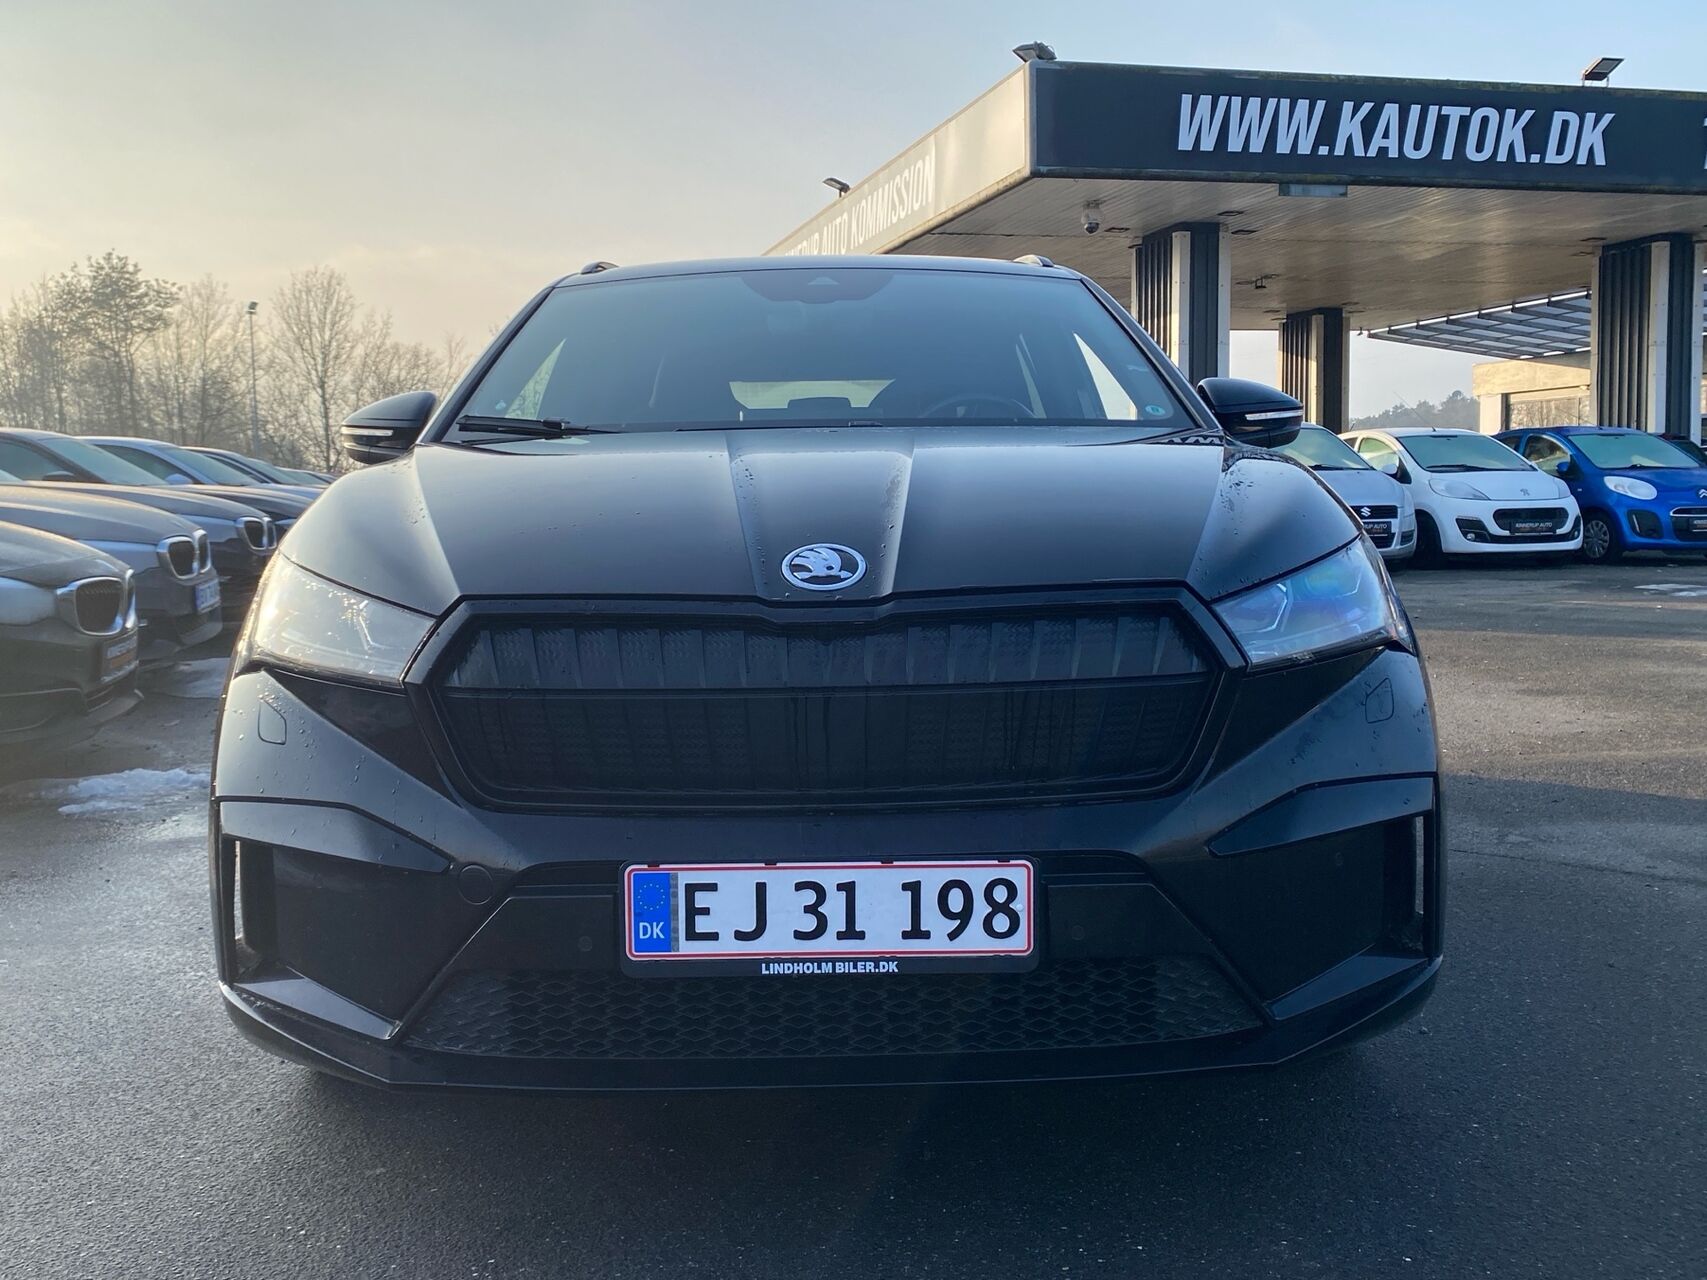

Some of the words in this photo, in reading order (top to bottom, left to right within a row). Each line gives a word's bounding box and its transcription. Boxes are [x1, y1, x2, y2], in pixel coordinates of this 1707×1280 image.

[1178, 94, 1615, 166] WWW.KAUTOK.DK
[822, 210, 848, 256] AUTO
[851, 155, 935, 249] KOMMISSION
[639, 922, 665, 939] DK
[684, 882, 767, 941] EJ
[793, 880, 866, 941] 31
[901, 877, 1021, 942] 198
[761, 962, 832, 975] LINDHOLM
[835, 961, 899, 974] BILER.DK
